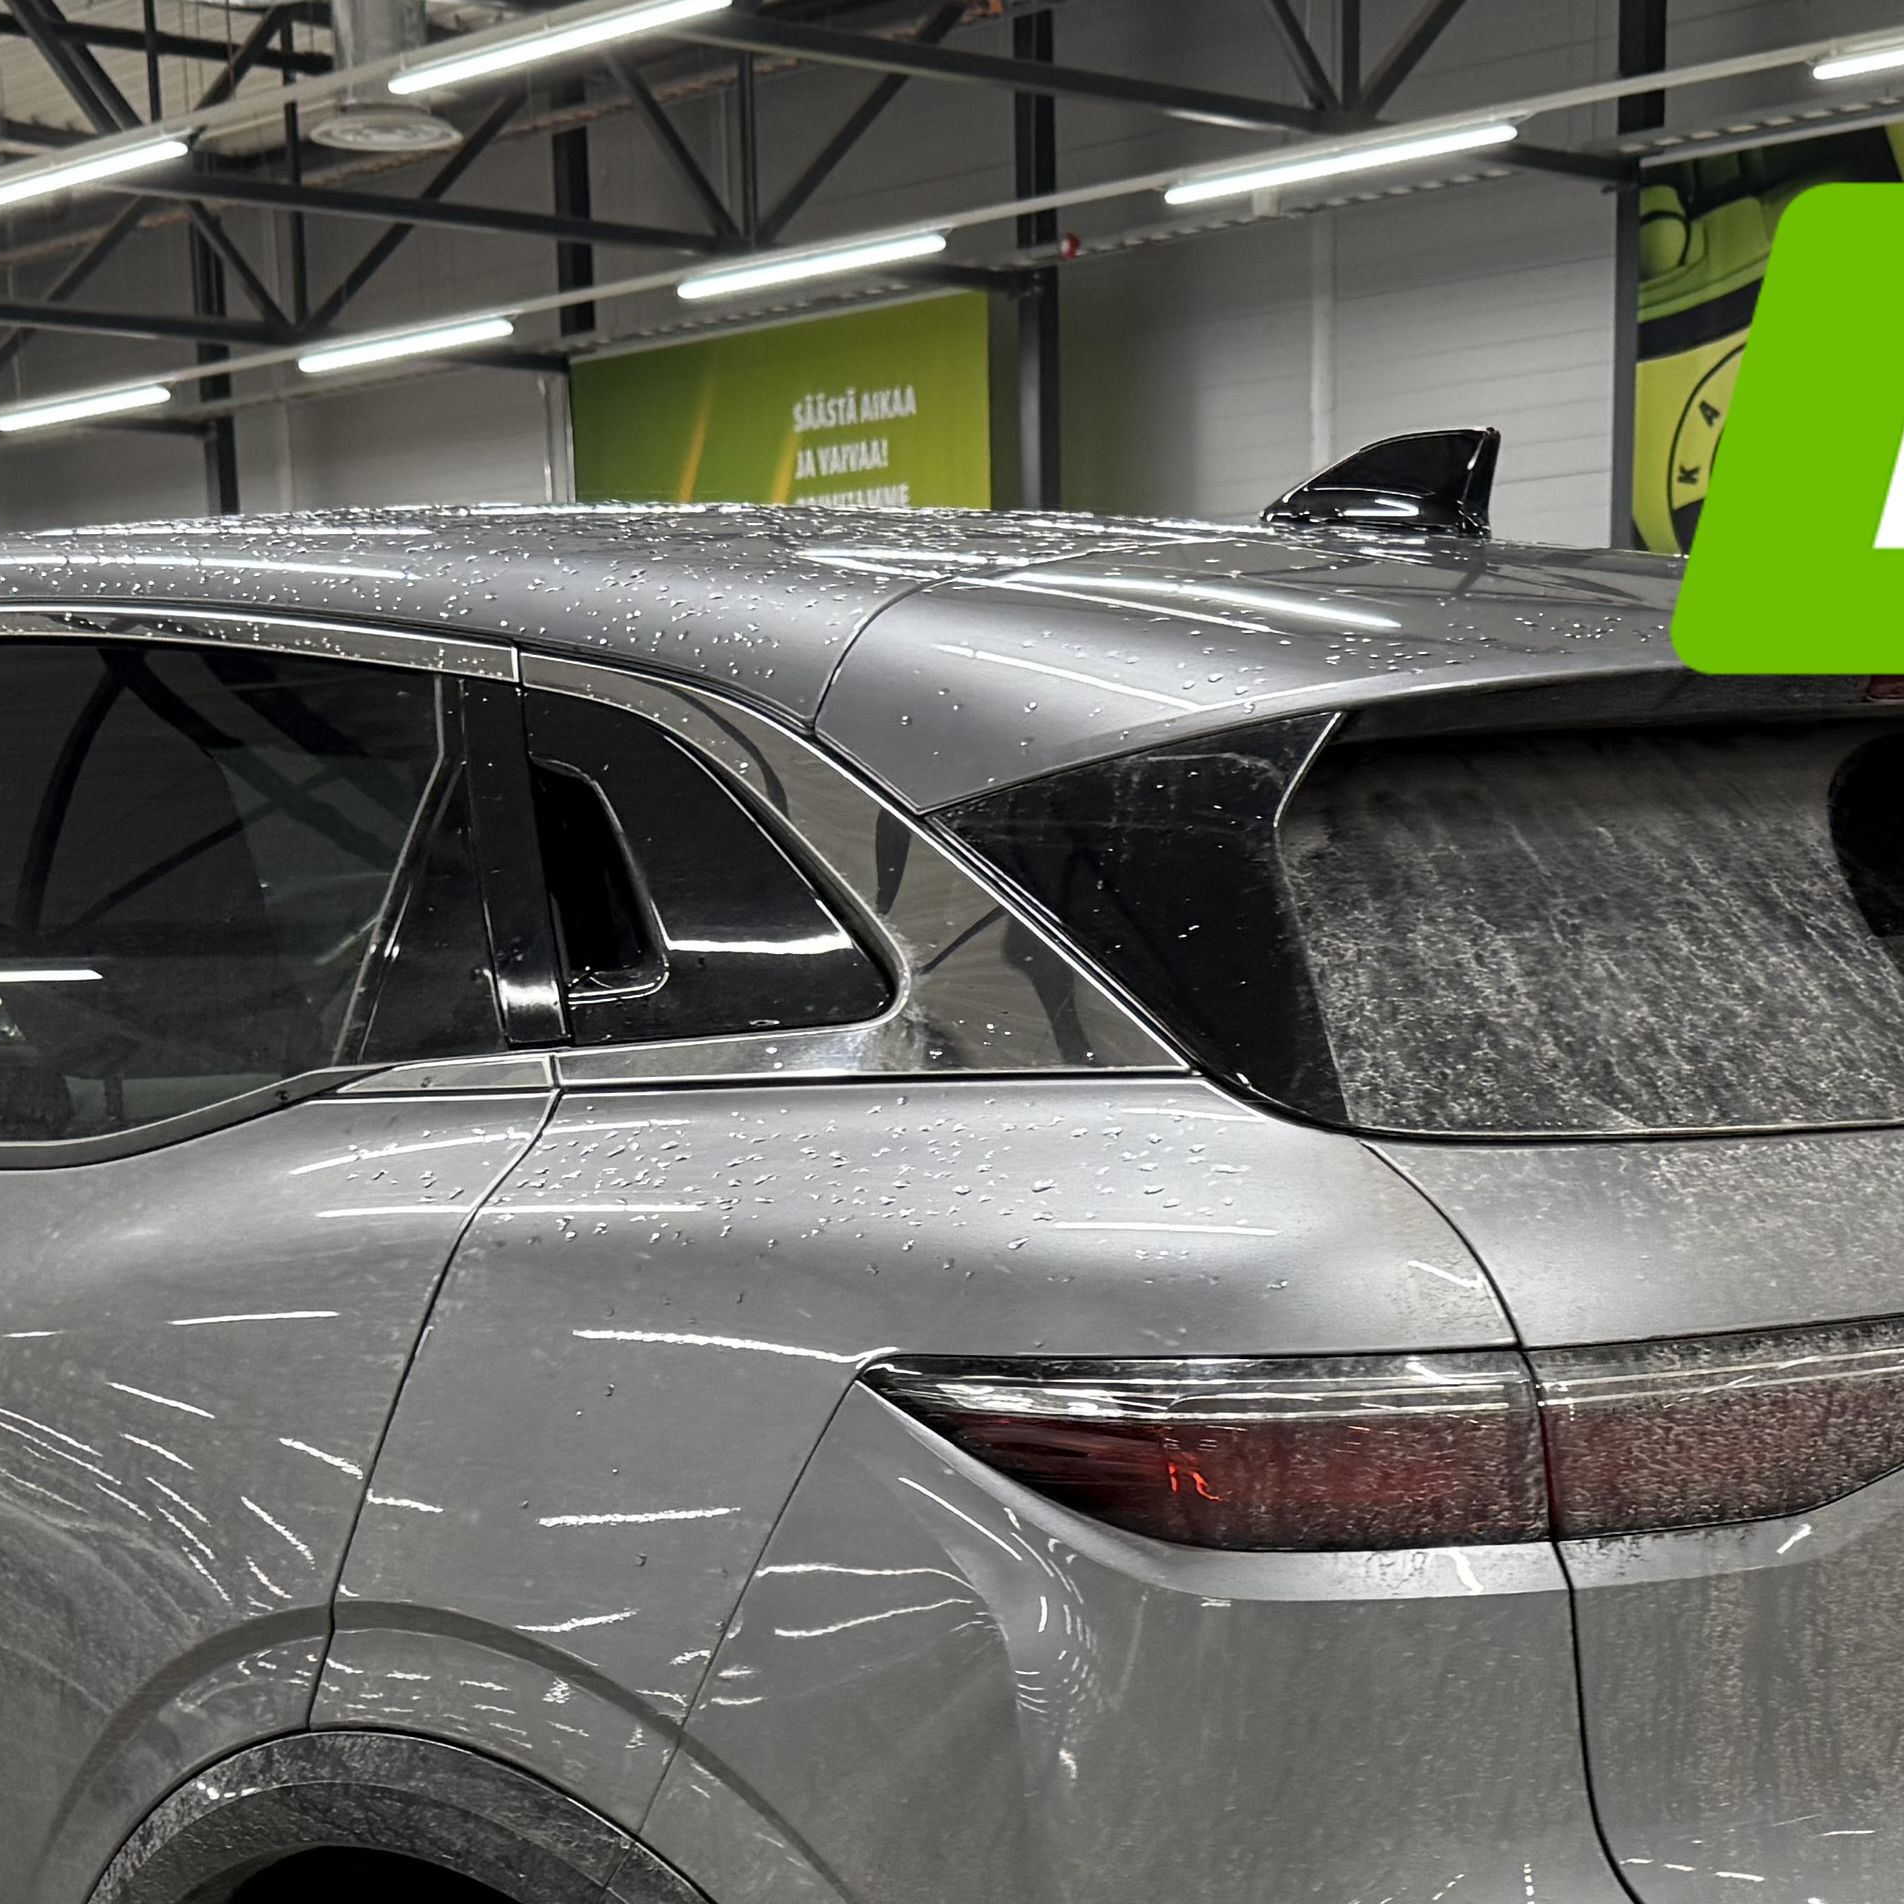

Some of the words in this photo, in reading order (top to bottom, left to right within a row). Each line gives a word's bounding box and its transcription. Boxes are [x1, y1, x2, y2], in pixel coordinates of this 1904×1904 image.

[792, 387, 858, 433] SÄÄSTÄ
[860, 384, 917, 424] AIKAA
[795, 447, 816, 480] JA
